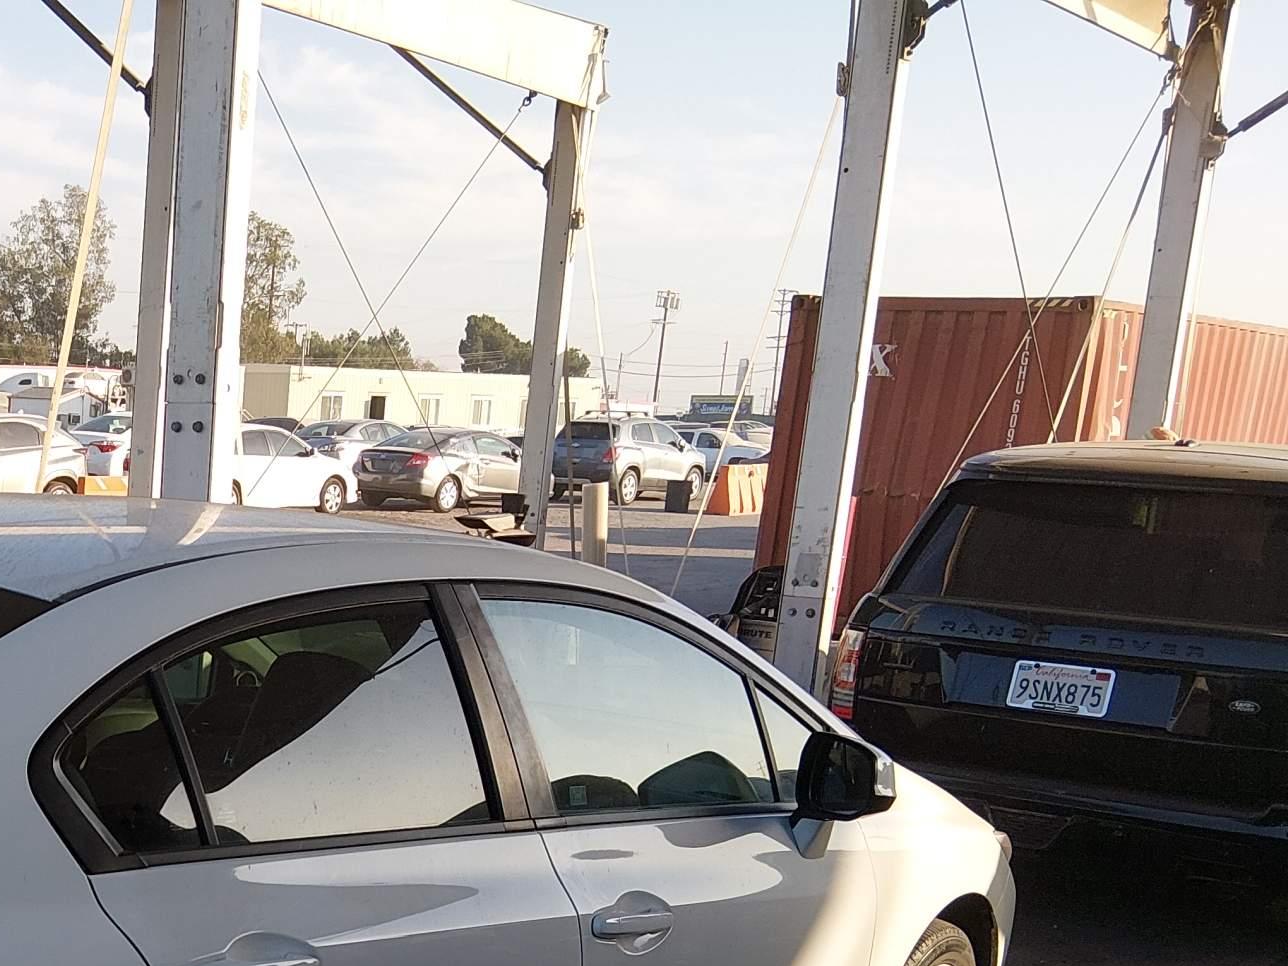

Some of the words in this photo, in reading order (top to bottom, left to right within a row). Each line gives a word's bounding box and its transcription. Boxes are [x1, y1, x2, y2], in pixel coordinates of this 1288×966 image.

[940, 620, 1052, 644] RANGE
[1079, 633, 1205, 658] ROVER
[1015, 677, 1103, 708] 9SNX875
